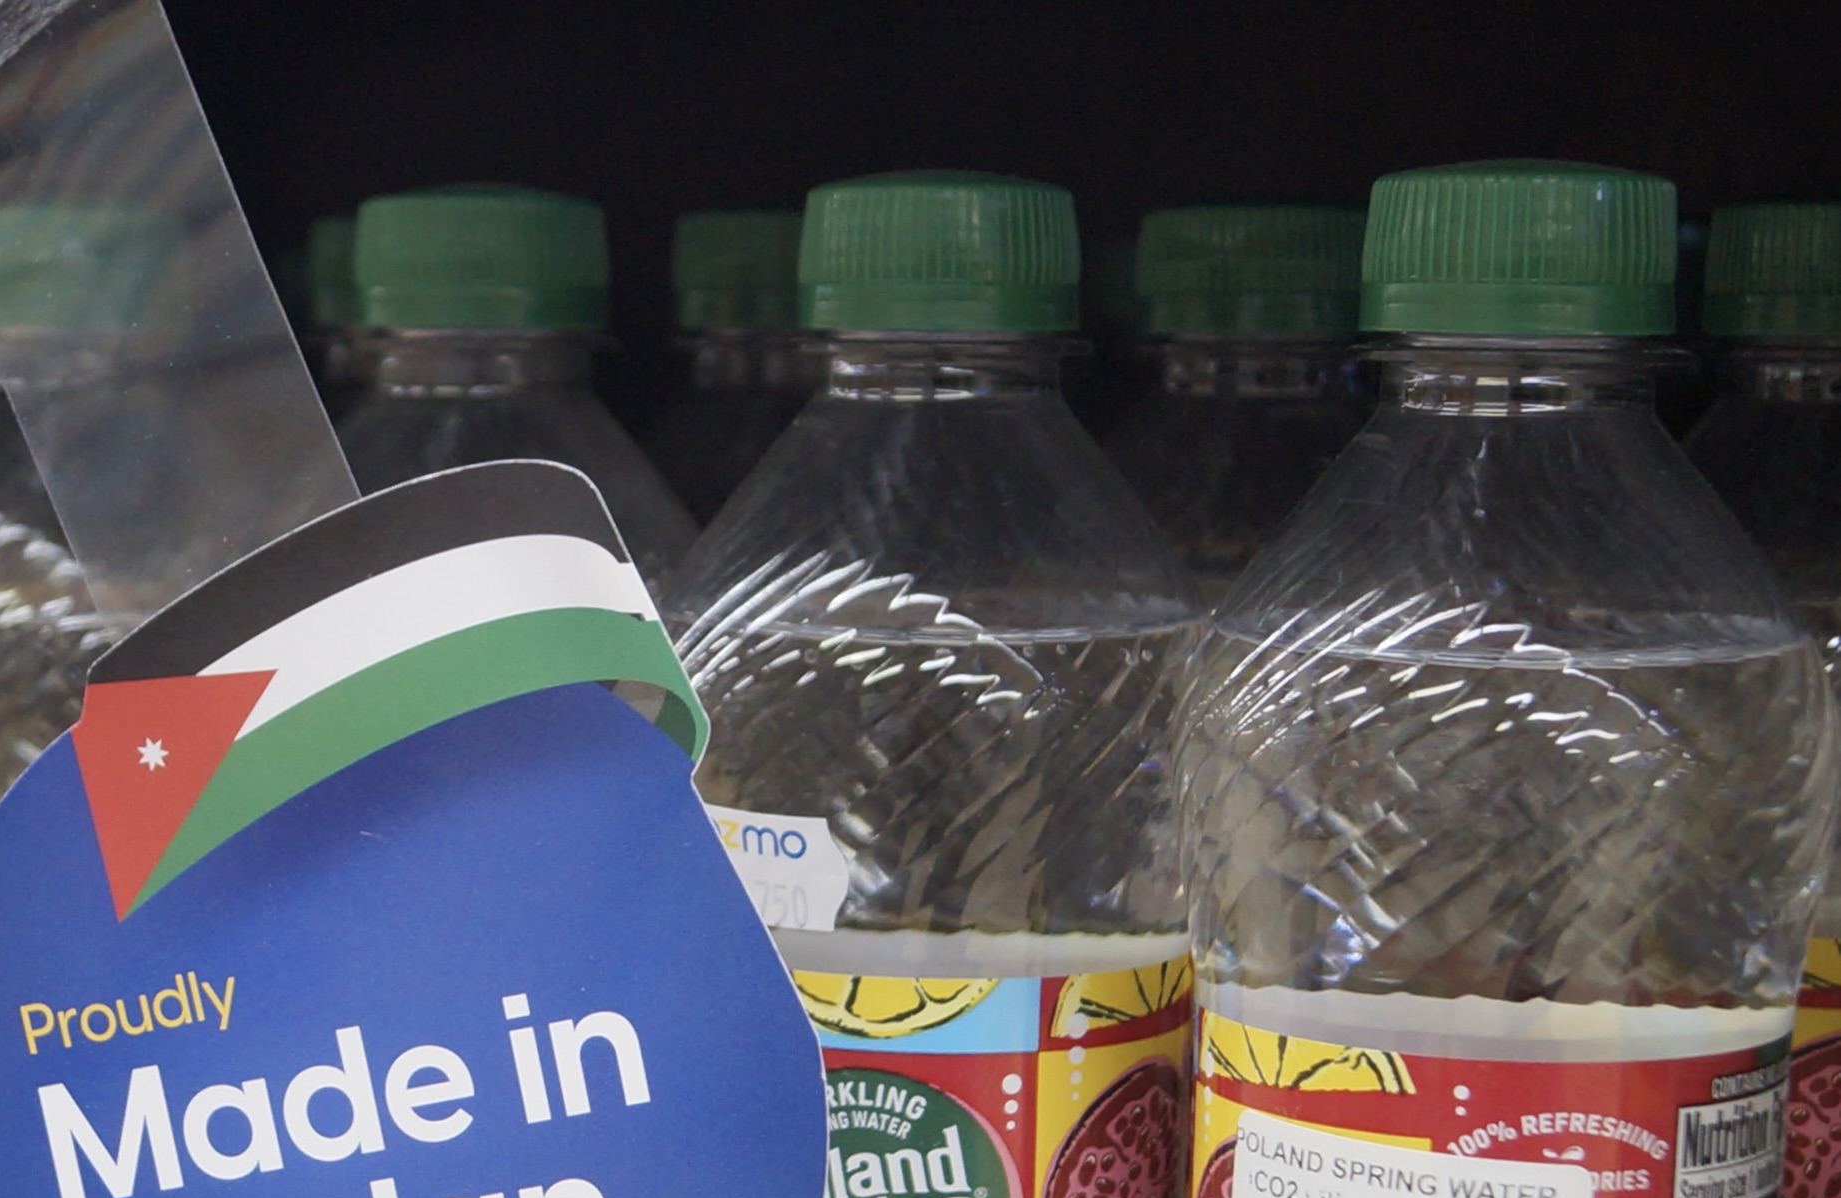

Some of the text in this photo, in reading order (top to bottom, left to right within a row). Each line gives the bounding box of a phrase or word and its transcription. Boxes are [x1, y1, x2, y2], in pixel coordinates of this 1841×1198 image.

[714, 819, 807, 859] zmo
[20, 971, 236, 1054] Proudly
[502, 993, 651, 1124] in
[826, 1081, 928, 1121] RKLING
[851, 1110, 912, 1140] WATER
[1236, 1125, 1325, 1174] POLAND
[1331, 1157, 1438, 1197] SPRING
[1447, 1112, 1670, 1161] 100% REFRESHING
[1681, 1101, 1769, 1169] Nutrition
